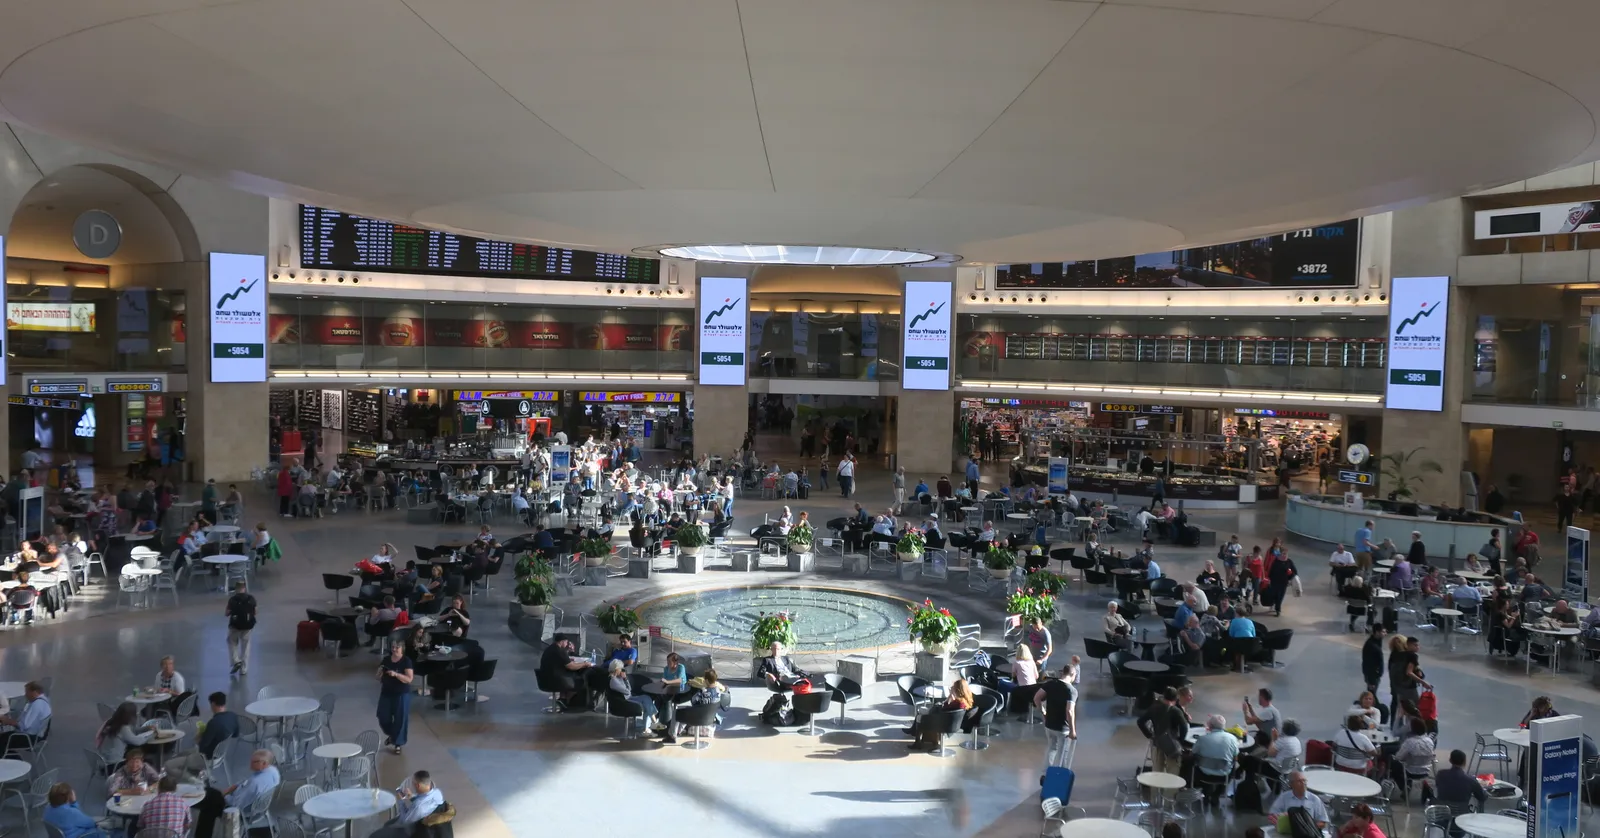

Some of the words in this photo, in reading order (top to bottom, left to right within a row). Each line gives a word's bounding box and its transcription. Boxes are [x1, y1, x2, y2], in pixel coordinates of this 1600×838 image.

[90, 224, 108, 245] D
[1316, 227, 1344, 239] אקרו
[1549, 774, 1563, 782] bigger
